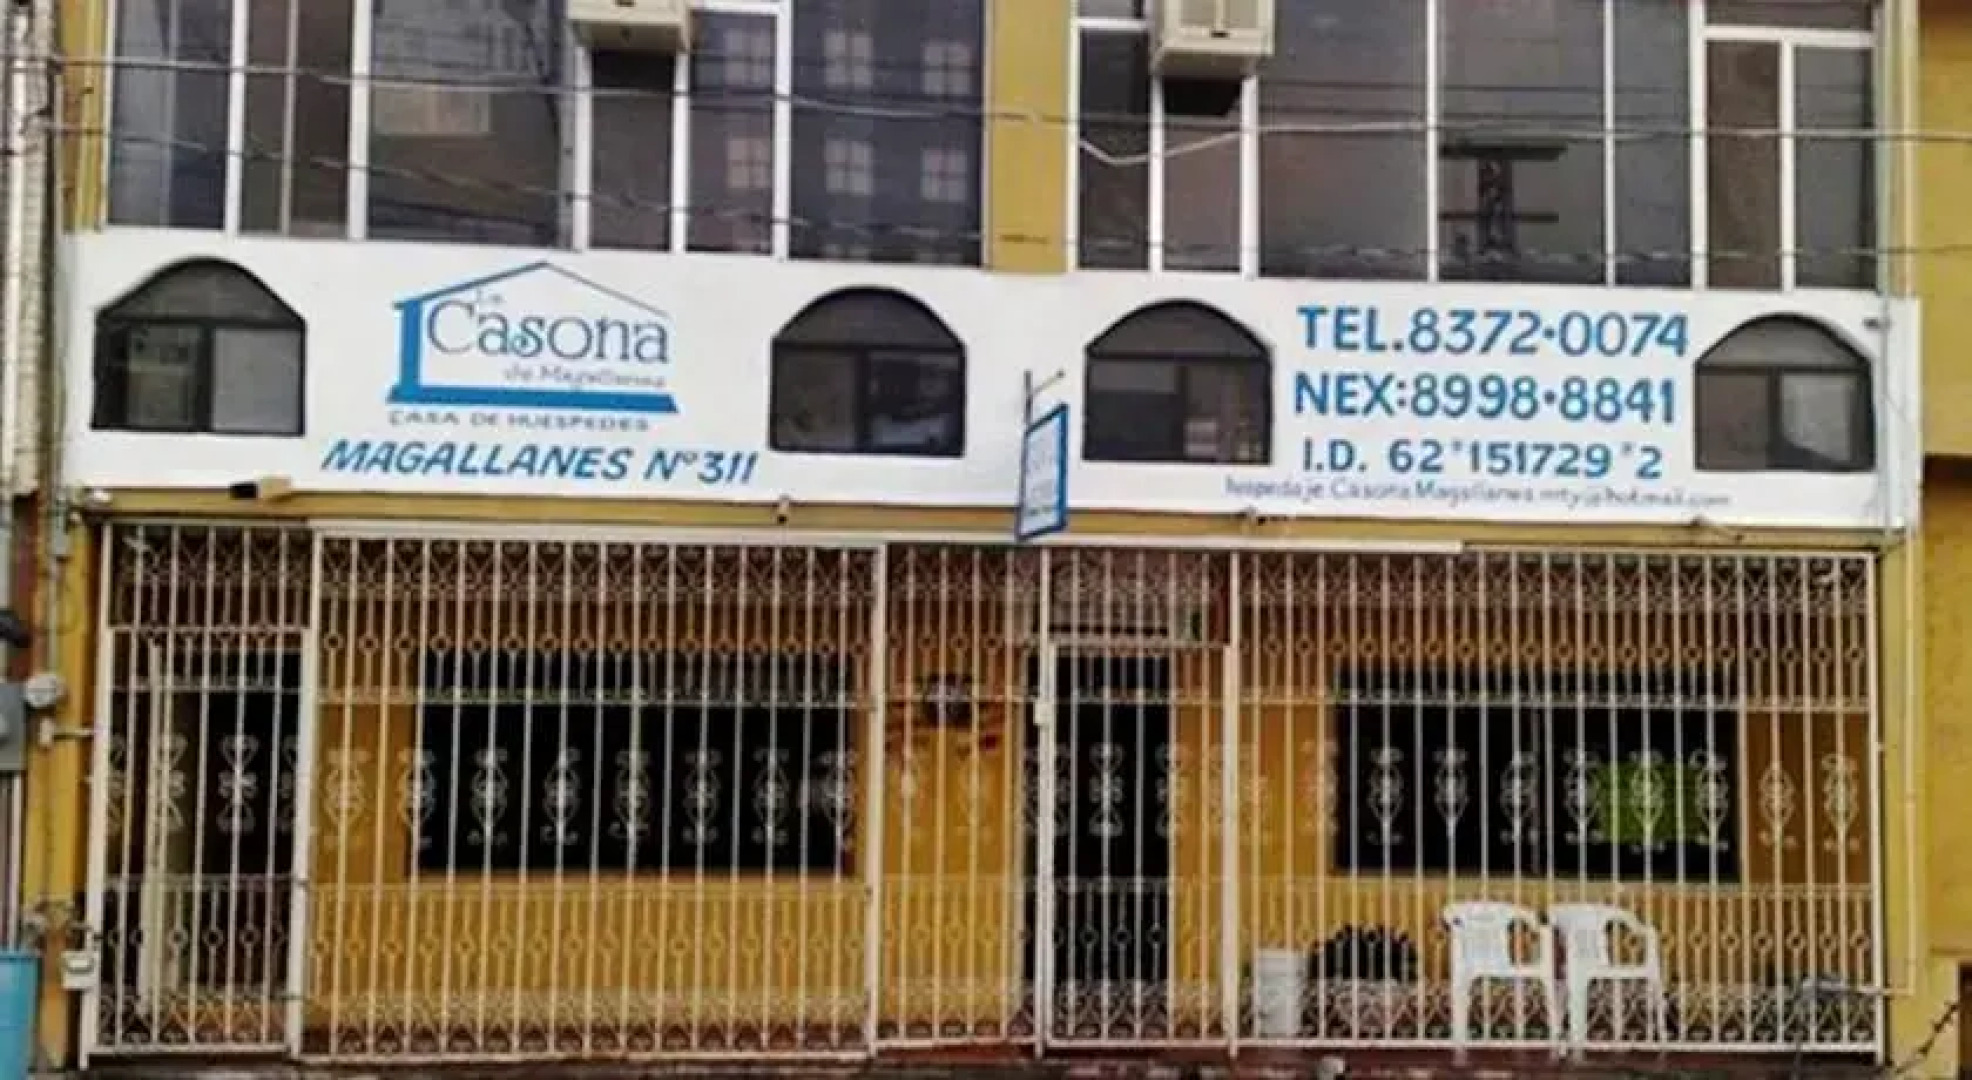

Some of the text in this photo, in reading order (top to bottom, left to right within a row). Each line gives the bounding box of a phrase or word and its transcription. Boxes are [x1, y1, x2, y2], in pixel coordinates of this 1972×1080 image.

[428, 299, 669, 364] Casona
[388, 410, 649, 432] CASA DE HUESPEDES
[321, 438, 634, 480] MAGALLANES
[1303, 437, 1367, 471] I.D.
